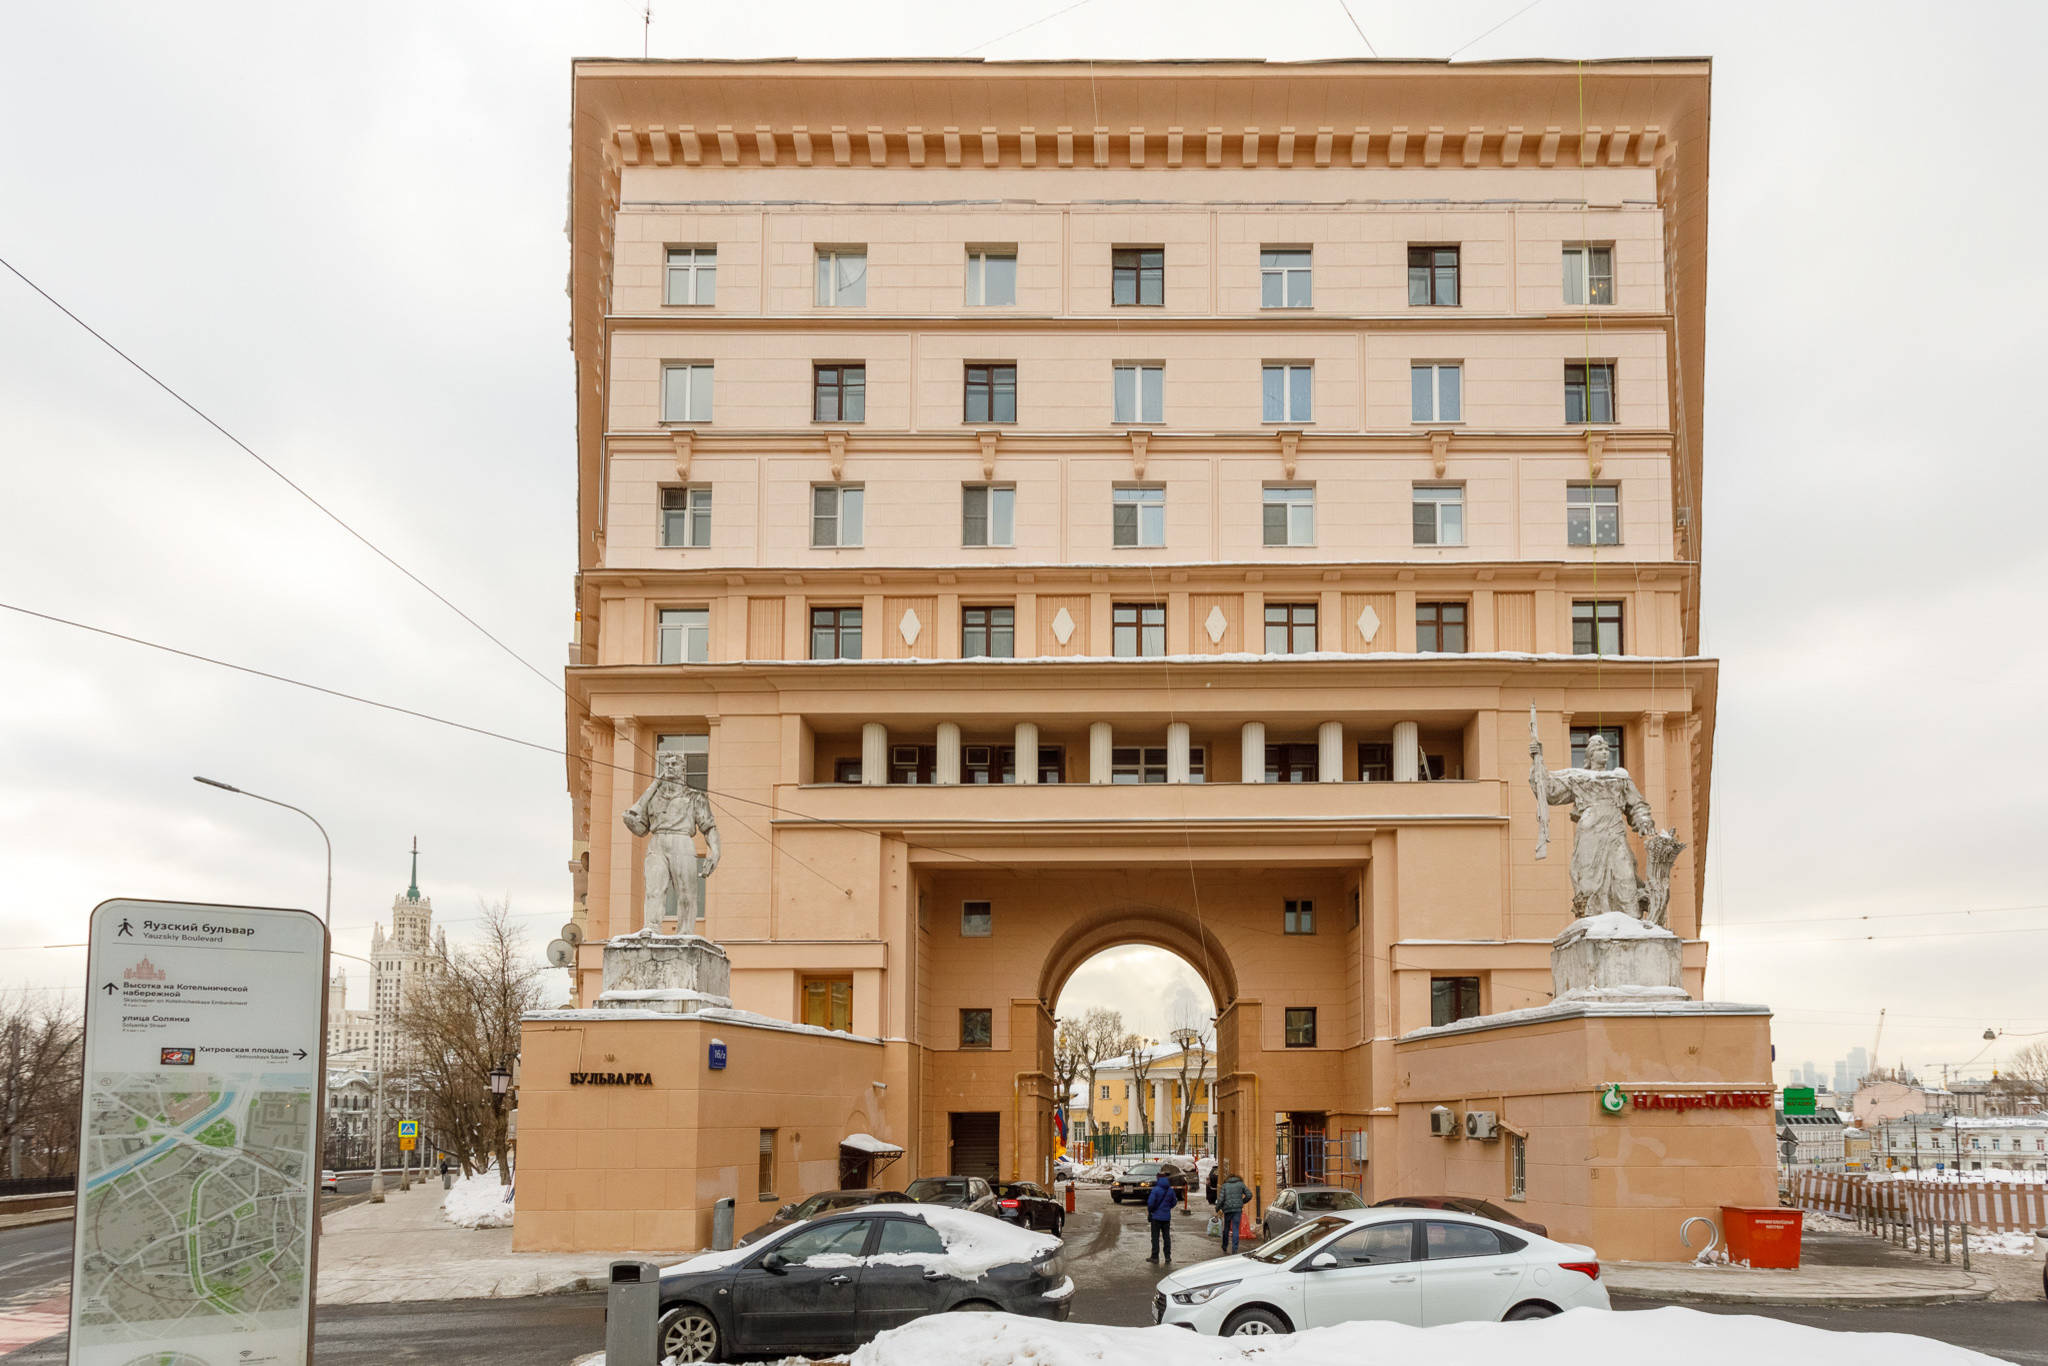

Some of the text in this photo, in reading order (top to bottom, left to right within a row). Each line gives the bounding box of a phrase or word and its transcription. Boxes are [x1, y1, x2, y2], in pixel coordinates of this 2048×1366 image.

[143, 920, 255, 936] Яузский бульвар
[143, 932, 223, 943] Yauzskiy Boulevard
[123, 982, 161, 990] Высотка
[176, 983, 248, 992] Котельнической
[123, 990, 181, 998] набережной
[151, 1015, 190, 1023] Солянка
[199, 1046, 290, 1055] Хитровская площадь
[569, 1072, 653, 1086] БУЛЬВАРКА
